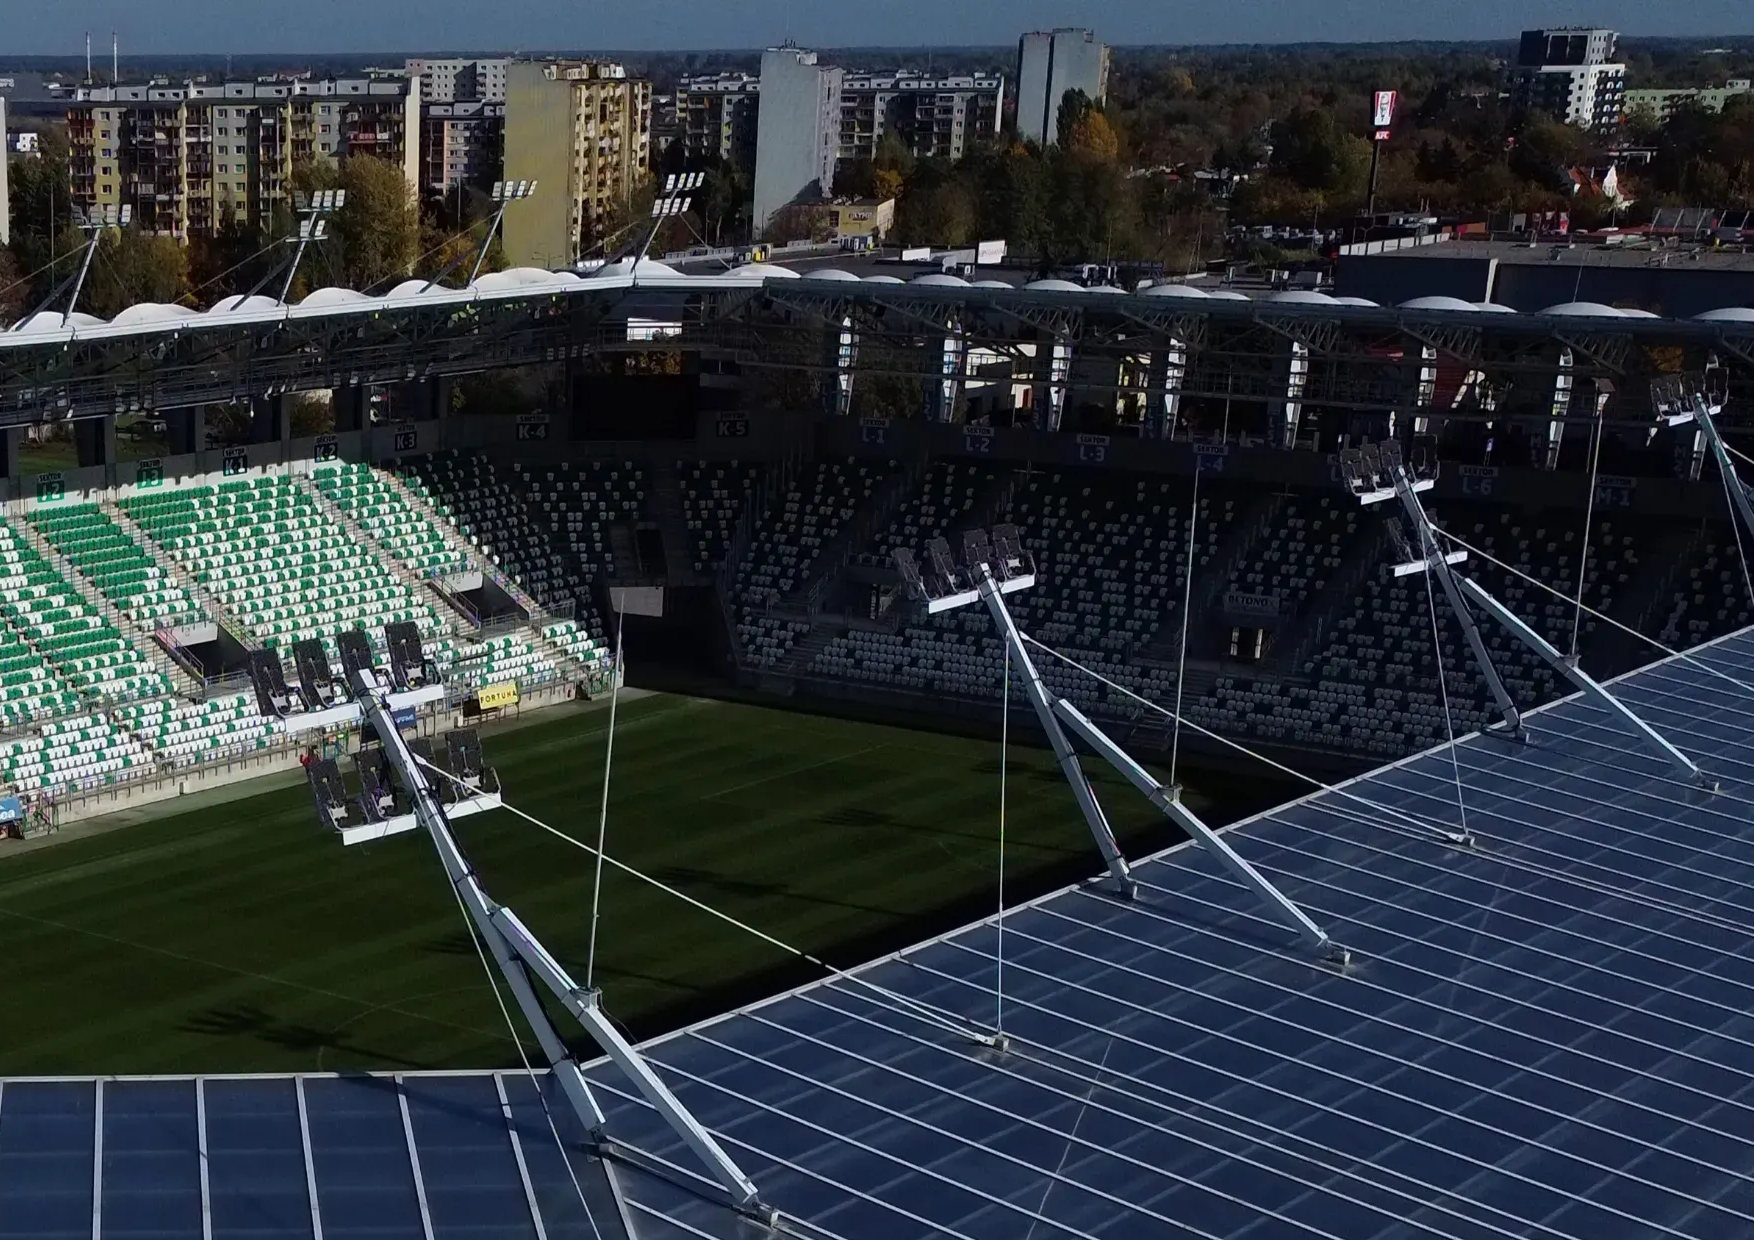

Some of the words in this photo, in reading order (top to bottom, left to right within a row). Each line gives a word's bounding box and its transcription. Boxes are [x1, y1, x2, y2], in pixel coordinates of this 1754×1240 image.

[518, 425, 547, 440] K-4
[718, 421, 747, 436] K-5
[396, 433, 415, 450] K-3
[967, 437, 991, 453] L-2
[316, 443, 336, 462] K-2
[1080, 445, 1105, 462] L-3
[225, 458, 246, 476] K-1
[1463, 477, 1492, 496] L-6
[480, 690, 517, 703] FORTUNA
